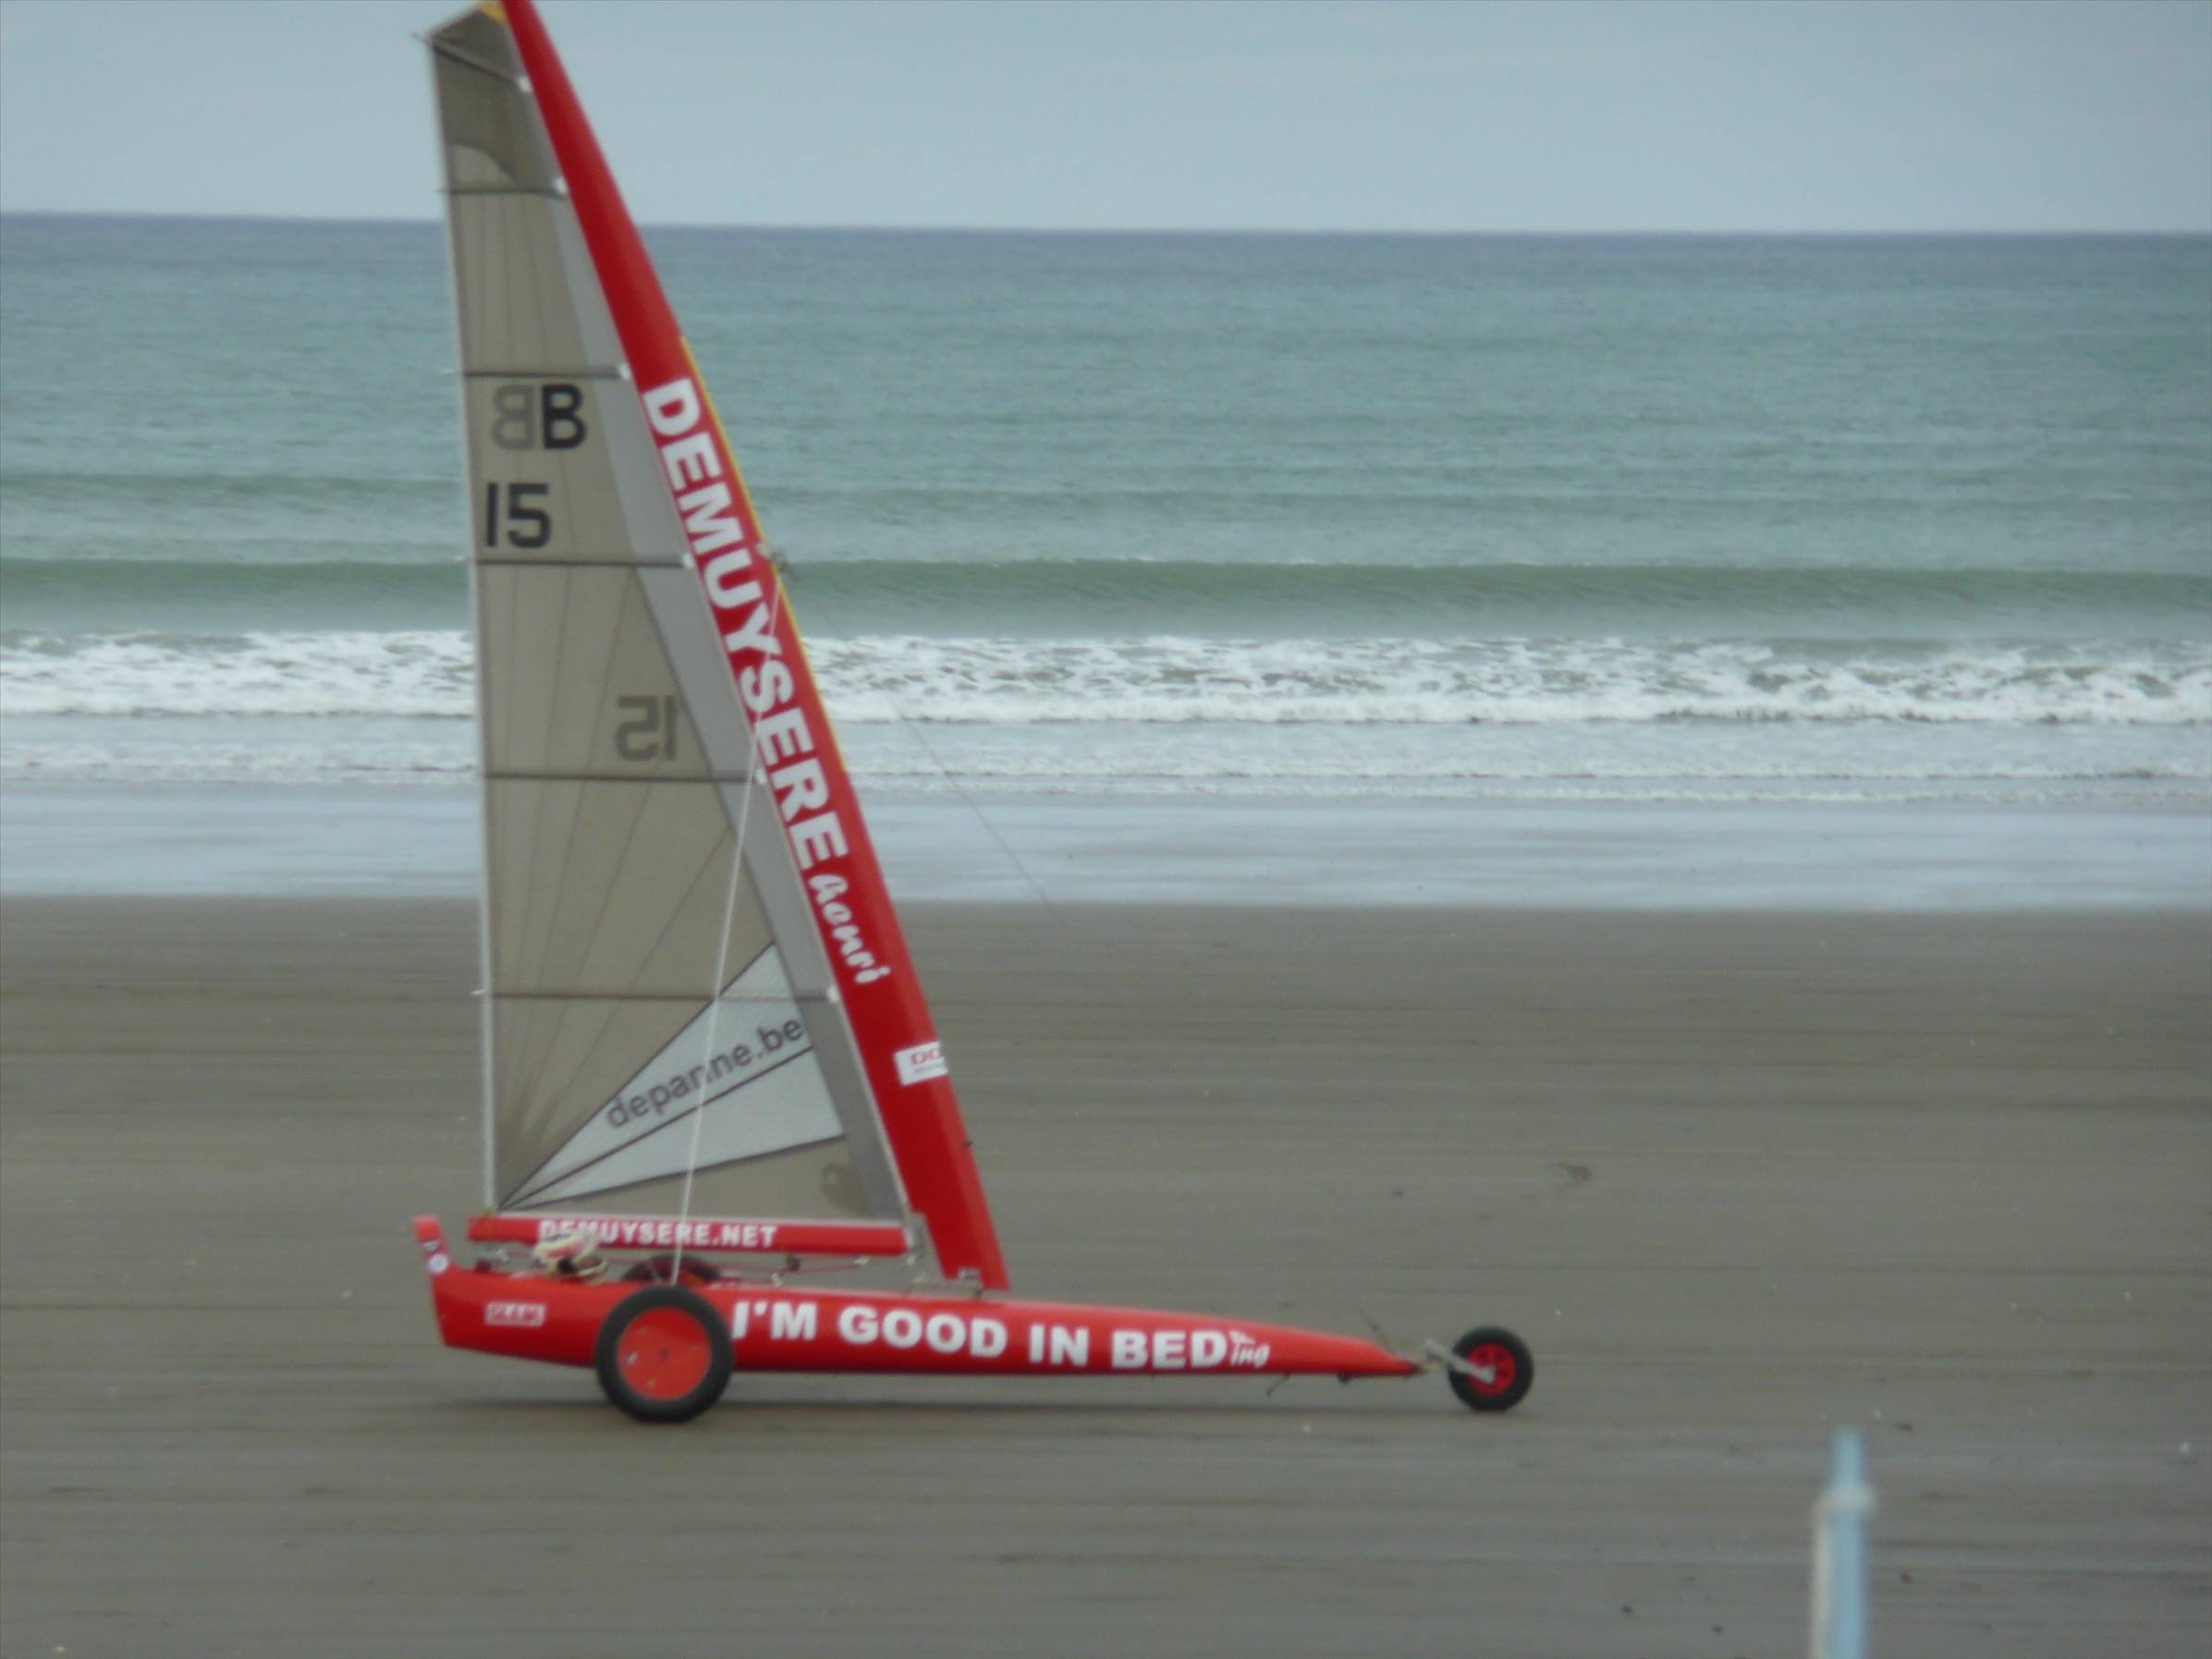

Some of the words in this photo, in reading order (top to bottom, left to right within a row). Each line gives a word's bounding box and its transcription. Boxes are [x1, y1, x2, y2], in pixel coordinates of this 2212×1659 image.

[541, 383, 587, 450] B
[485, 481, 552, 549] 15
[642, 377, 849, 870] DEMUYSERE
[606, 1019, 804, 1129] depanne.be
[733, 1301, 818, 1341] I'M
[838, 1304, 1008, 1358] GOOD
[1029, 1324, 1090, 1365] IN
